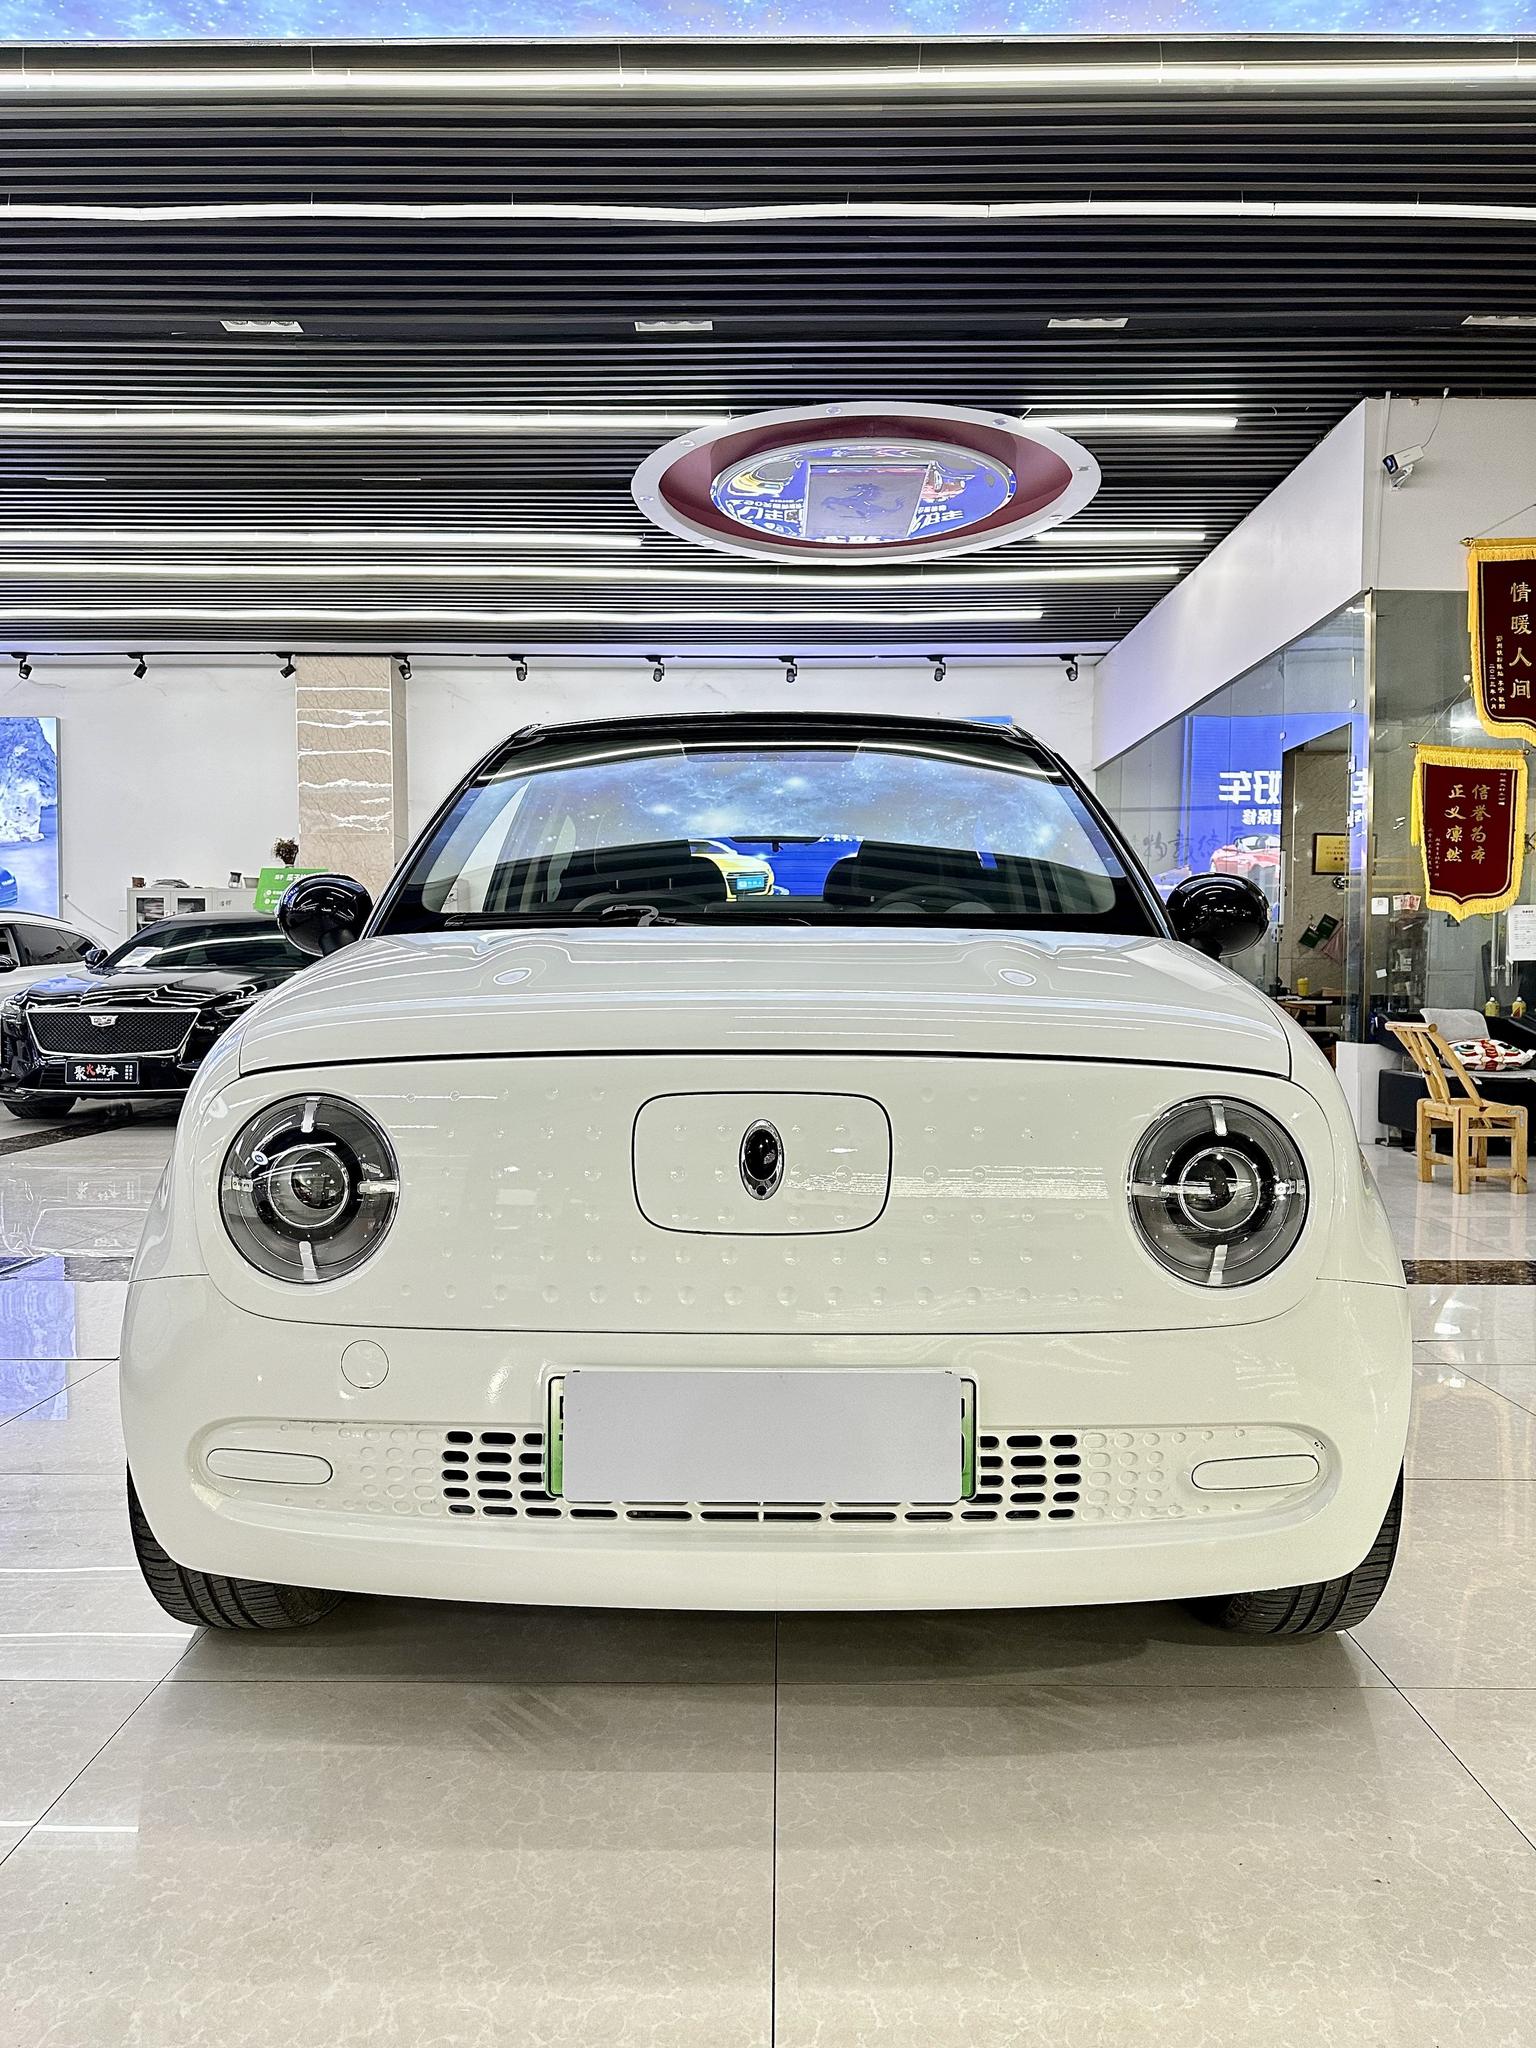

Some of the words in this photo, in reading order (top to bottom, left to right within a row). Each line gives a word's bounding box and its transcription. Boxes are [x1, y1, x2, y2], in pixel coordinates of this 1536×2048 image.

[1509, 581, 1533, 699] 情暖人间
[1444, 784, 1467, 862] 正义凛然
[1470, 784, 1491, 865] 信誉为本
